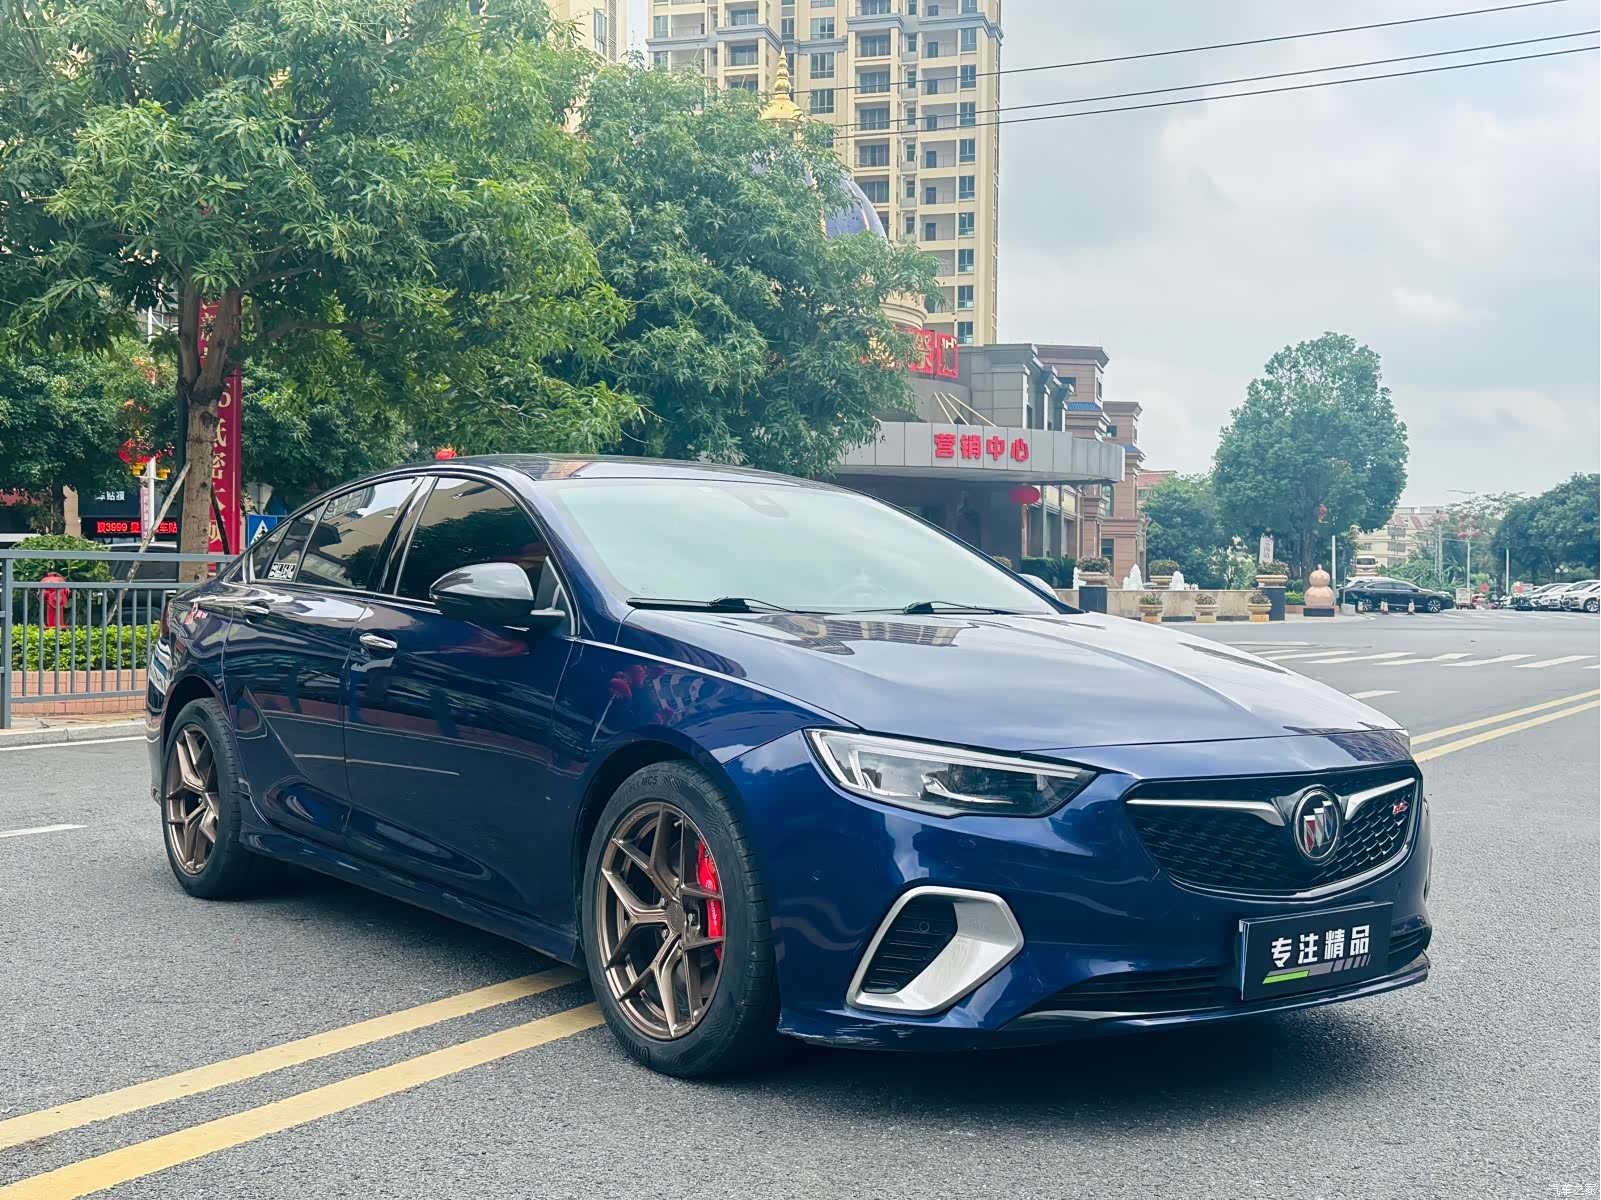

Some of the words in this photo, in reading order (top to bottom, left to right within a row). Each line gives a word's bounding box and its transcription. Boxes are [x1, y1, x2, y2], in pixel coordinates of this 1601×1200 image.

[934, 433, 1029, 462] 营销中心
[1271, 924, 1370, 968] 专注精品
